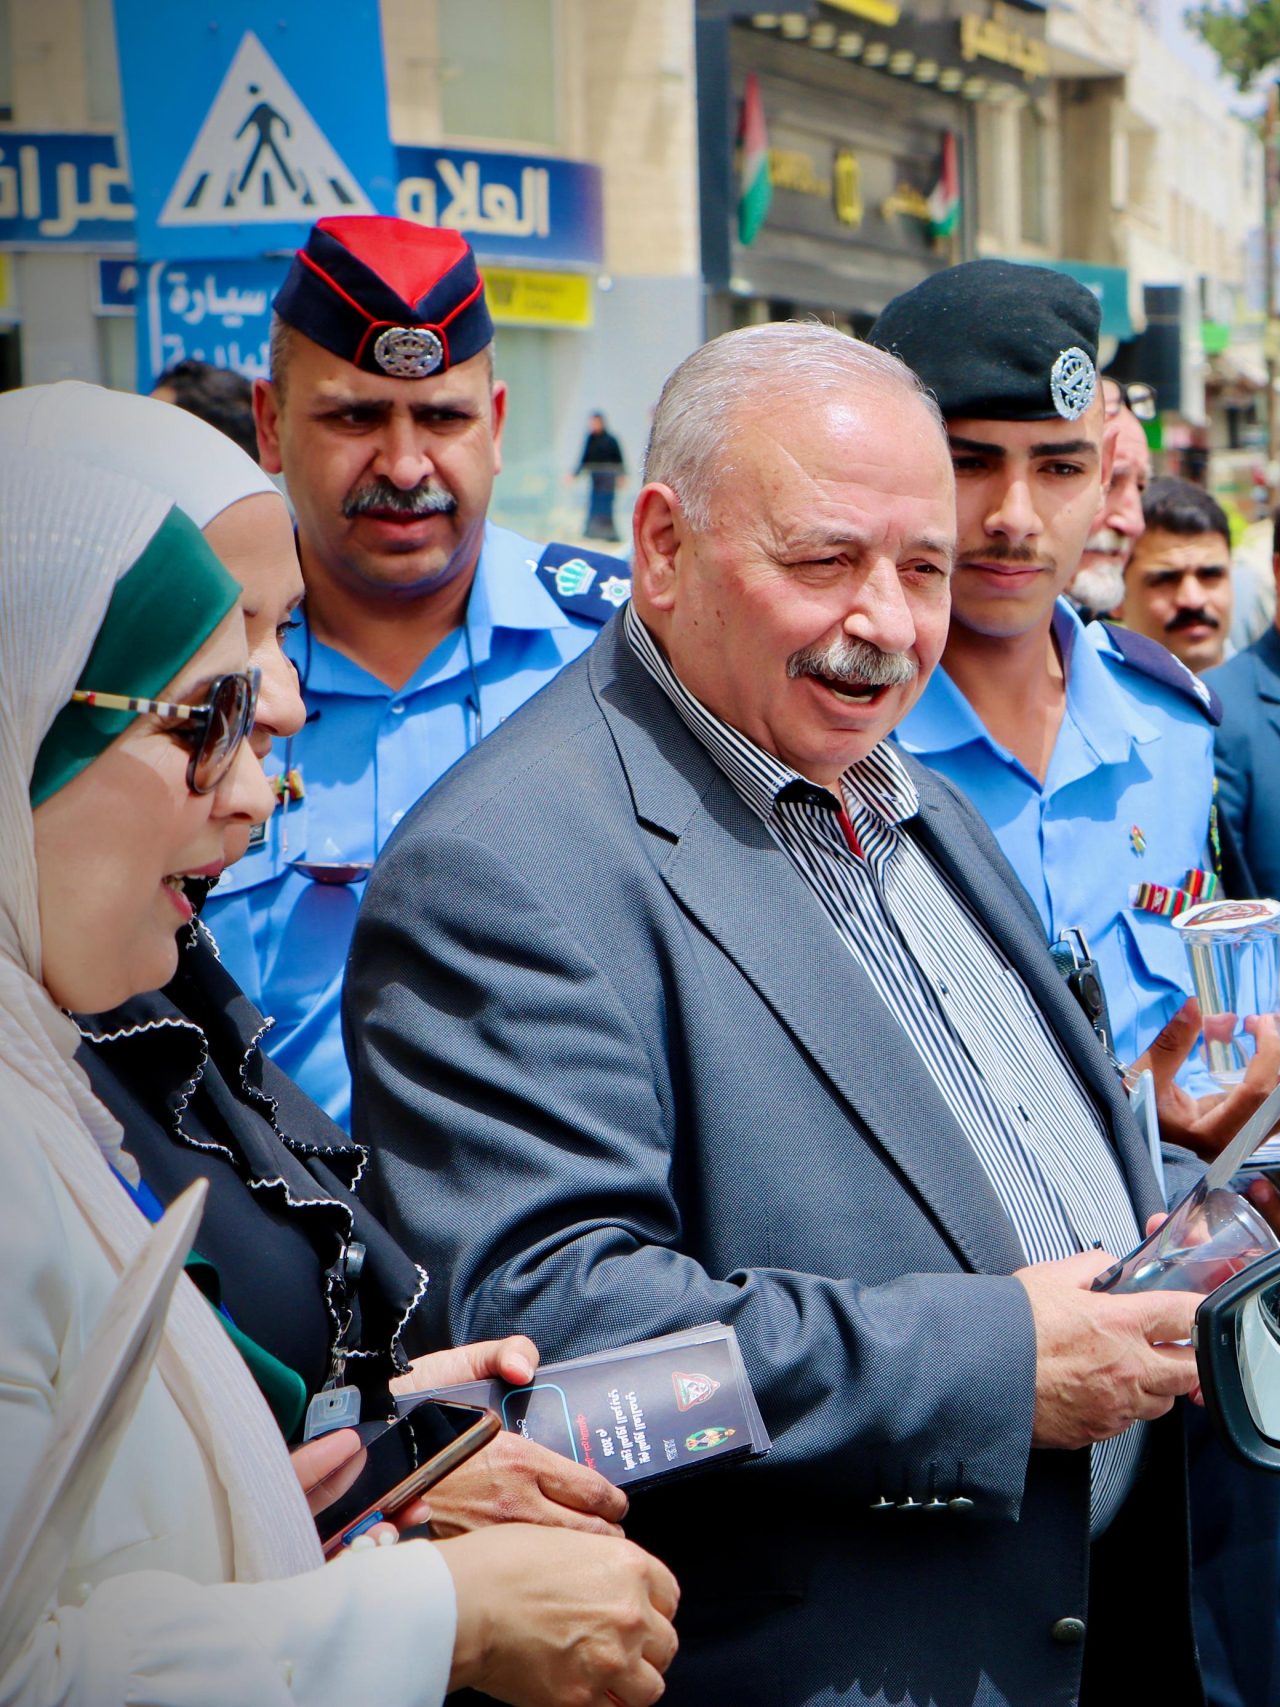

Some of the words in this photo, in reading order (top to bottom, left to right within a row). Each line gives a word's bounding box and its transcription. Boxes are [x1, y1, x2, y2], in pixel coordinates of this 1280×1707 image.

[396, 158, 549, 238] العلاو
[167, 272, 266, 328] سيارة
[608, 1389, 627, 1424] العربي
[625, 1391, 646, 1431] العالمي
[595, 1428, 608, 1438] م
[615, 1425, 633, 1450] المرور
[633, 1430, 651, 1452] المرور
[600, 1437, 615, 1457] 2026
[638, 1452, 651, 1464] يوم
